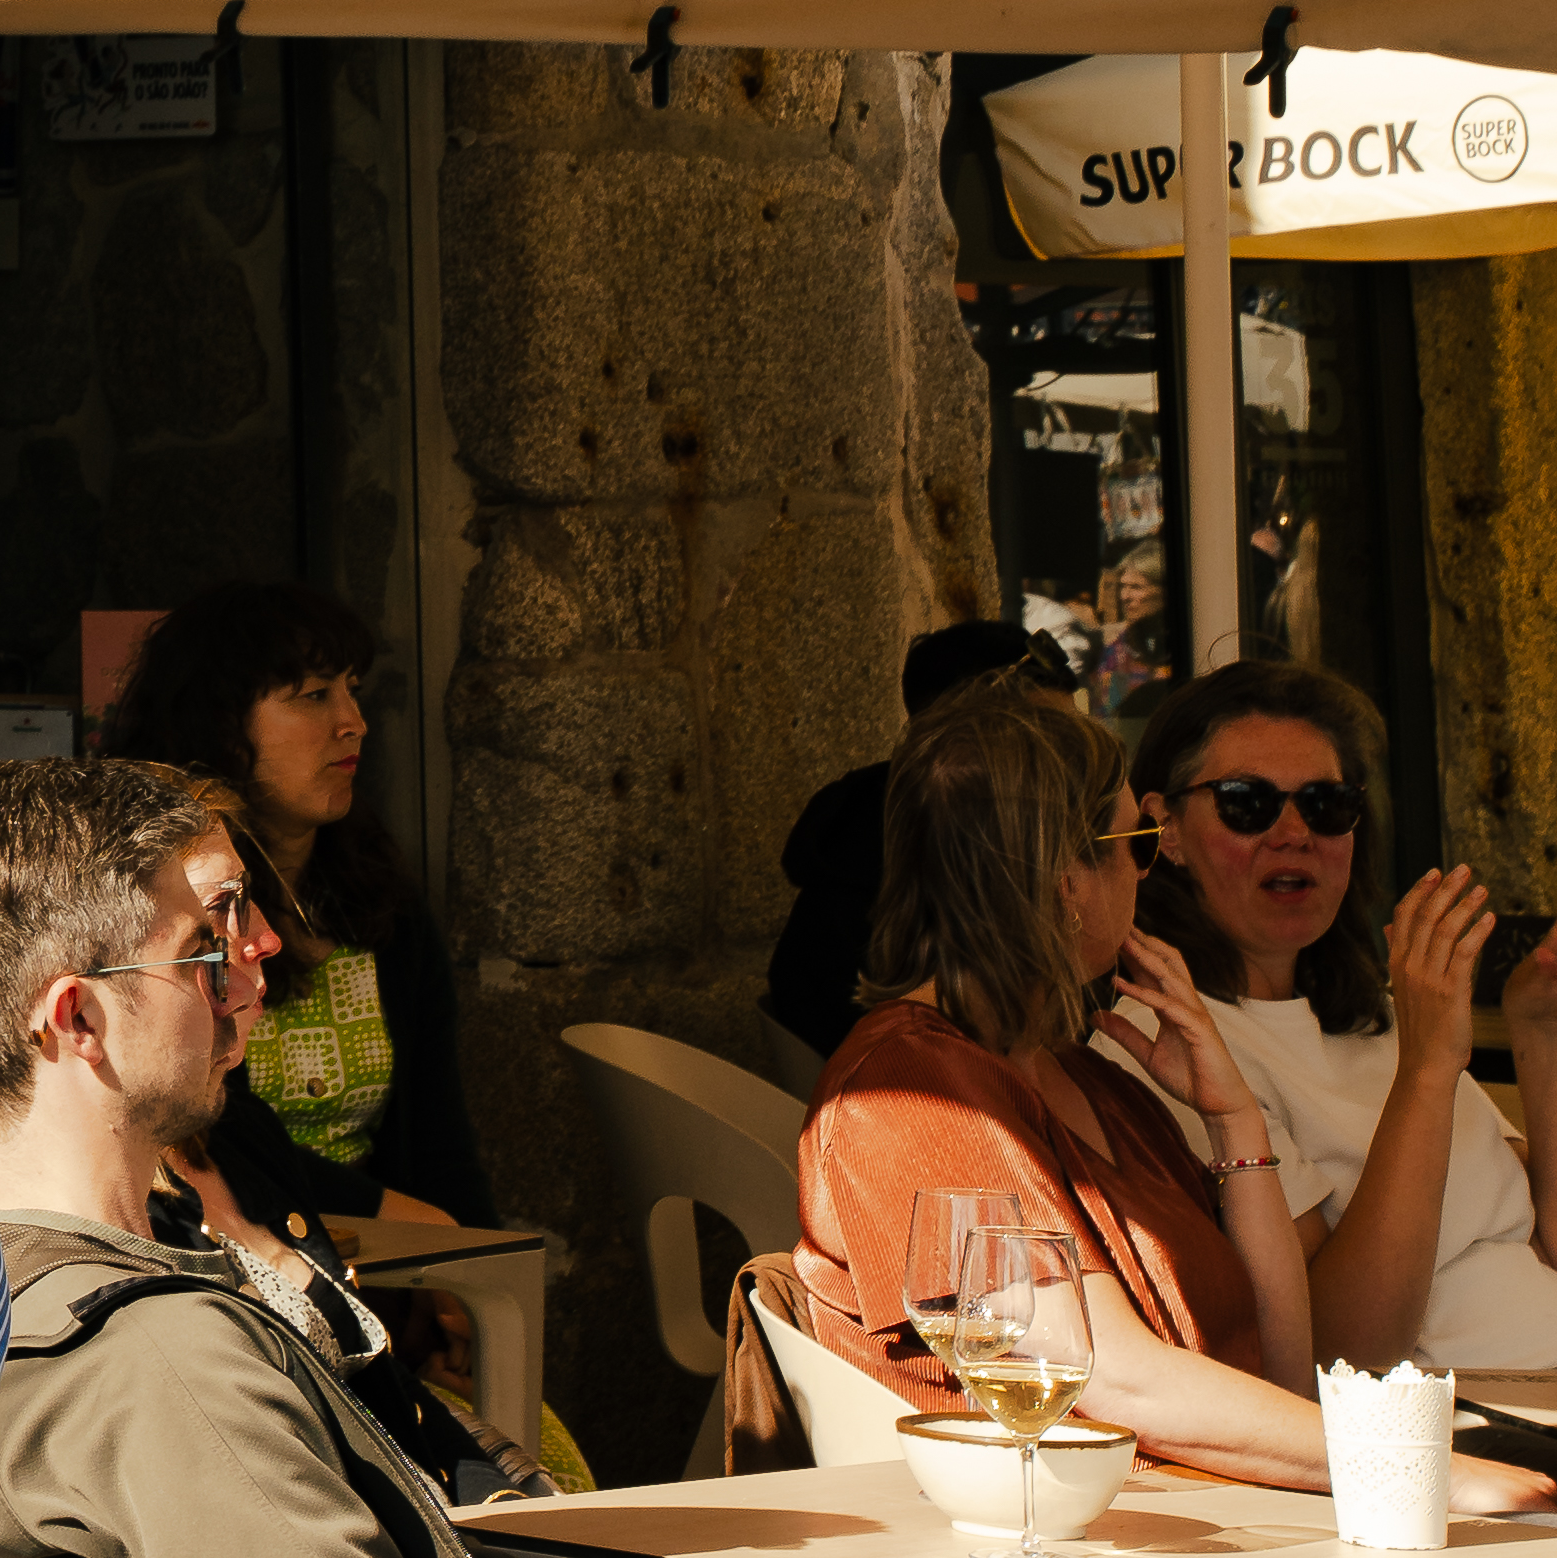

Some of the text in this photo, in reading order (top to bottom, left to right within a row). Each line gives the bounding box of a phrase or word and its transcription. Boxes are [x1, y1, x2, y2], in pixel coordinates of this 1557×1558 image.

[132, 61, 178, 80] PRONTO
[1461, 118, 1517, 140] SUPER
[1465, 137, 1516, 159] BOCK
[1079, 119, 1425, 208] SUPR BOCK
